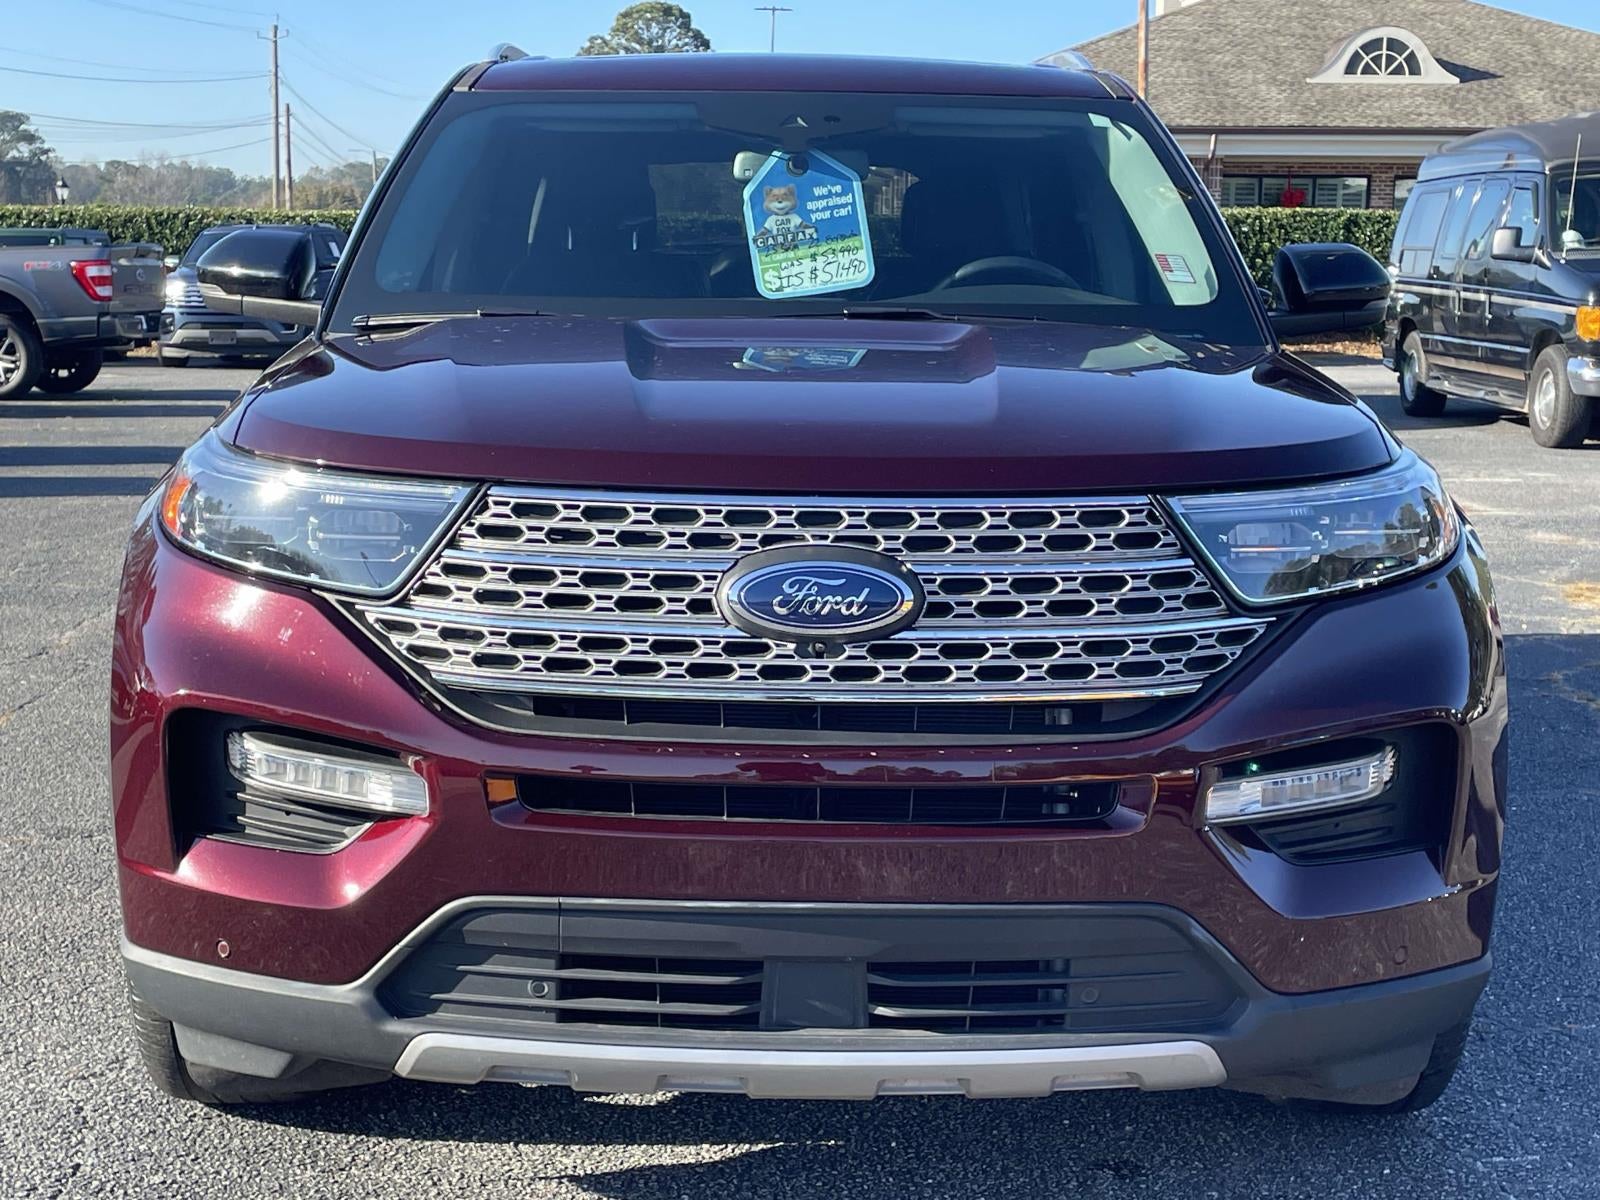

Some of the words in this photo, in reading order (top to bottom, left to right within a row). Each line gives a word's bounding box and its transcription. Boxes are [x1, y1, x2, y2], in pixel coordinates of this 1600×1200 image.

[813, 184, 842, 197] We've
[806, 193, 853, 211] appraised
[775, 218, 791, 226] CAR
[810, 209, 831, 223] your
[756, 231, 817, 248] CARFAX
[773, 576, 870, 616] Ford
